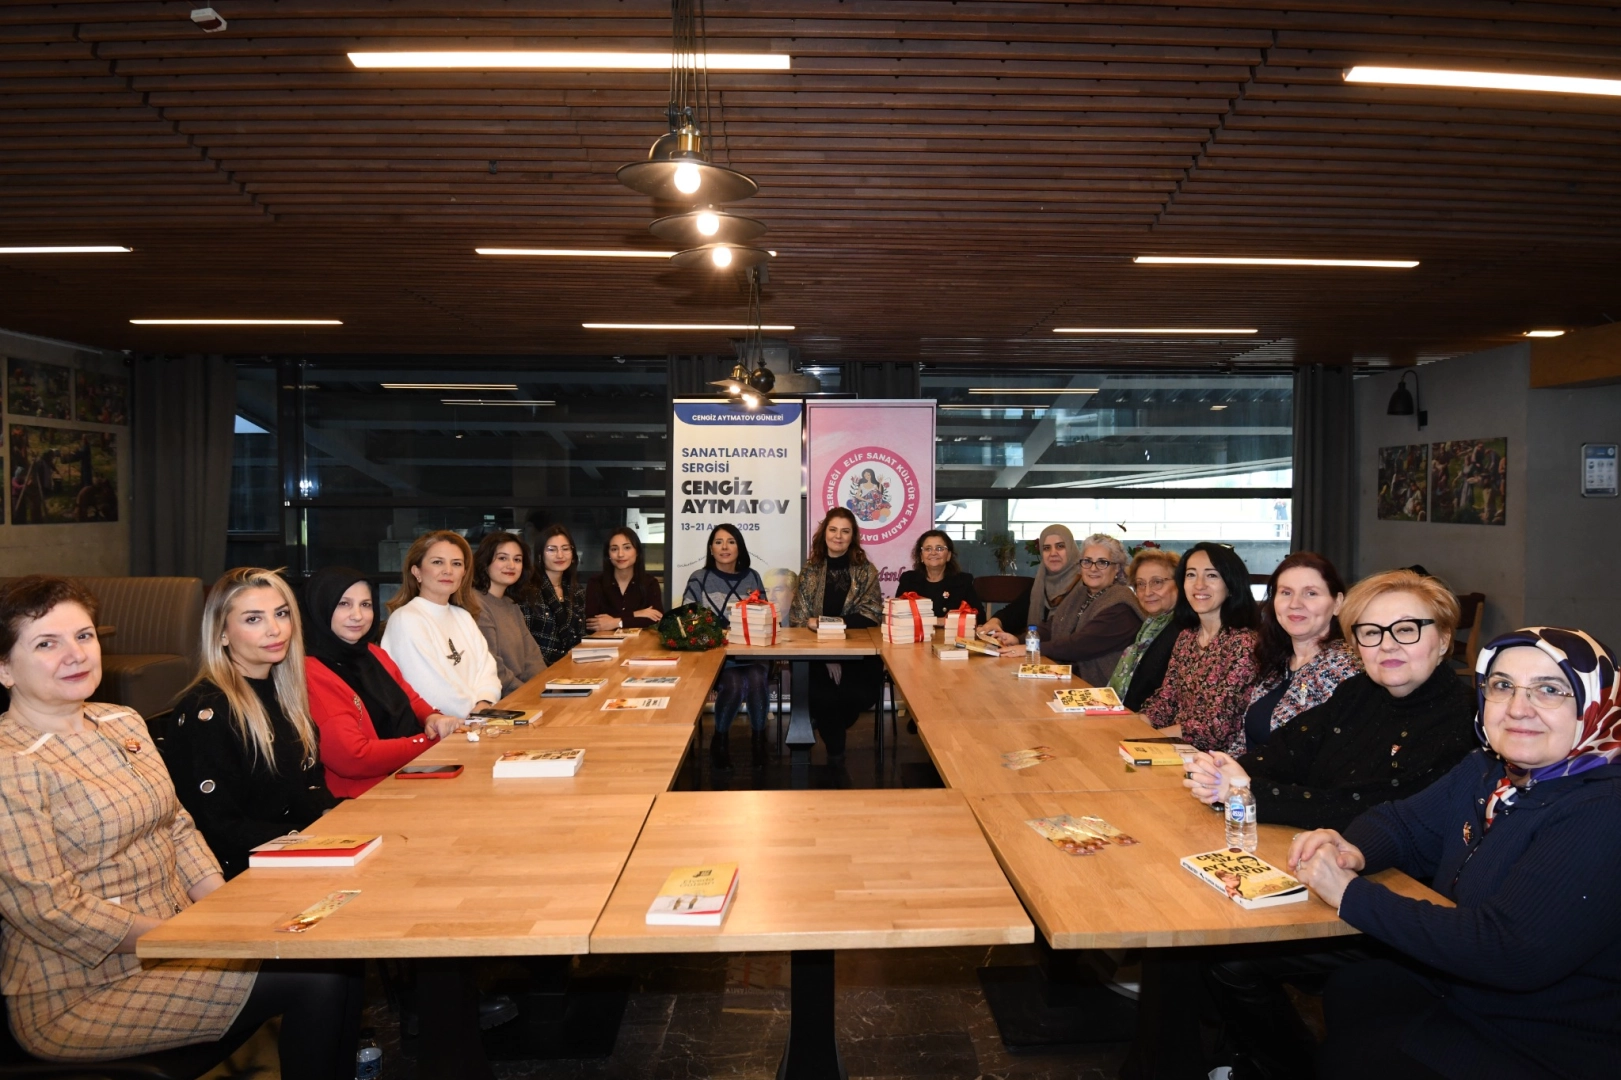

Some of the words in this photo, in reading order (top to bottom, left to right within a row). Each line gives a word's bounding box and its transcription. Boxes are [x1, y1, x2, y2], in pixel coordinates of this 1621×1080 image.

[692, 413, 716, 421] CENGİZ
[756, 413, 784, 421] GÜNLERİ
[682, 447, 788, 458] SANATLARARASI
[866, 452, 897, 466] SANAT
[682, 460, 730, 473] SERGİSİ
[843, 453, 863, 468] ELİF
[681, 476, 753, 496] CENGİZ
[896, 464, 916, 500] KÜLTÜR
[681, 499, 790, 515] AYTMATOV
[905, 503, 915, 516] VE
[681, 523, 705, 531] 13-21
[737, 523, 760, 531] 2025
[881, 517, 908, 540] KADIN
